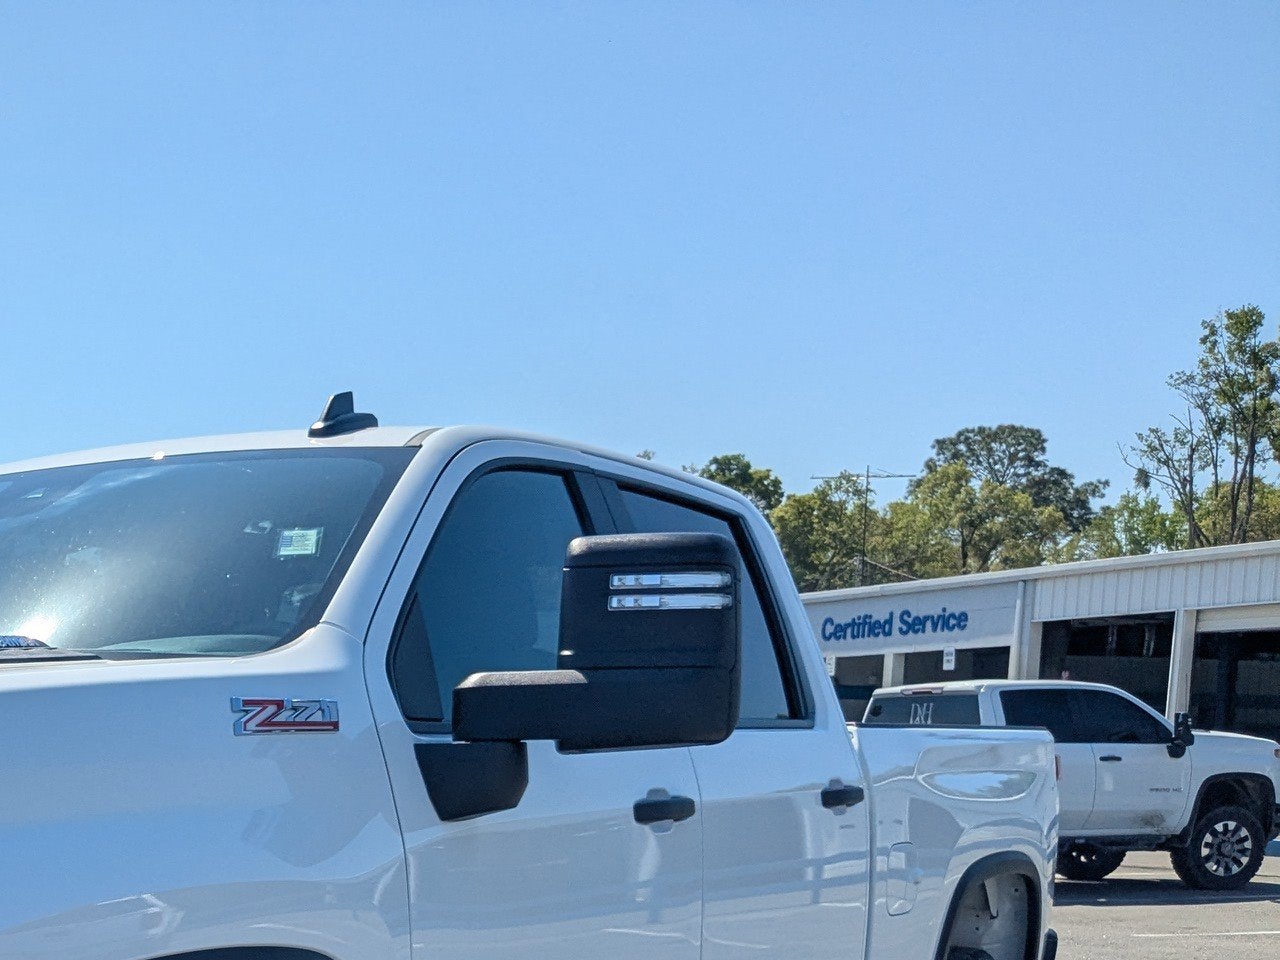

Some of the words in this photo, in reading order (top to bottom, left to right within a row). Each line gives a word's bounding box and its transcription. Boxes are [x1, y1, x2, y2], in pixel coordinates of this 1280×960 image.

[821, 611, 894, 641] Certified
[898, 607, 969, 636] Service
[230, 697, 340, 736] Z71
